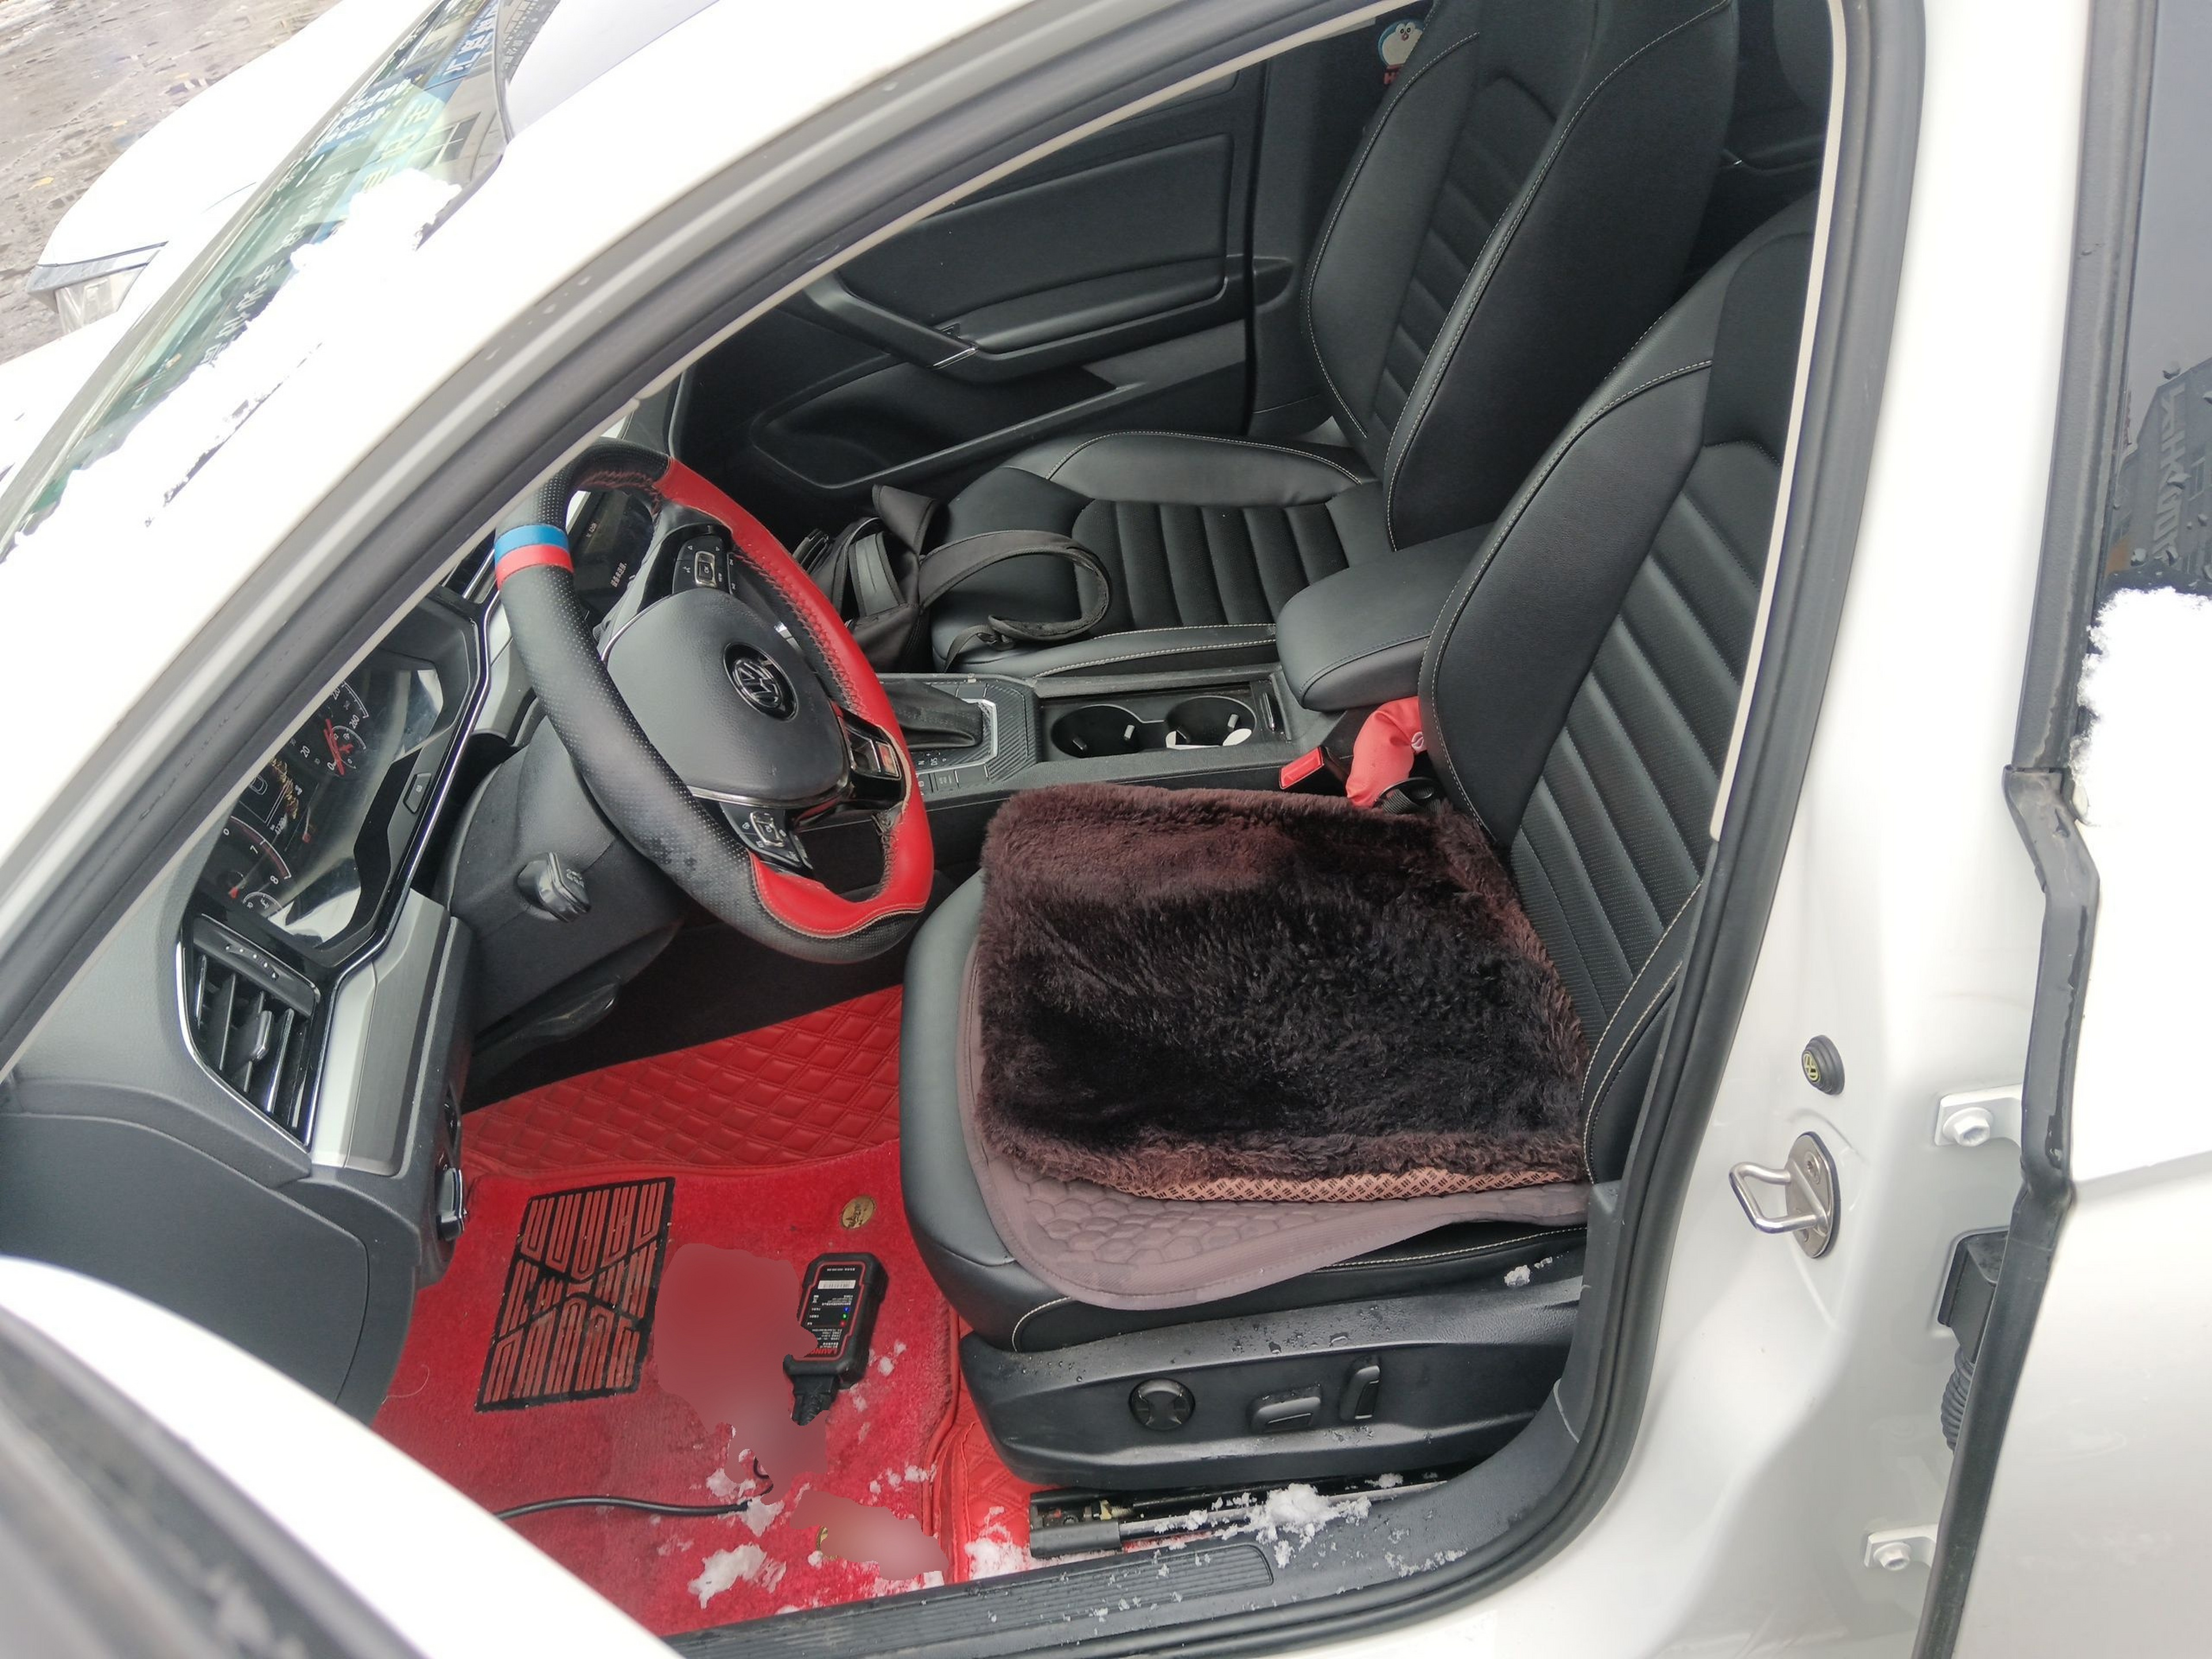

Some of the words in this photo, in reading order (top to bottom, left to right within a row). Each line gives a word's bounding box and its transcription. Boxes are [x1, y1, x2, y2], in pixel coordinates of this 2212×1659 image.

[349, 714, 359, 729] 260
[300, 745, 310, 758] 20
[327, 762, 334, 771] 0
[250, 845, 258, 854] 7
[270, 875, 279, 884] 8
